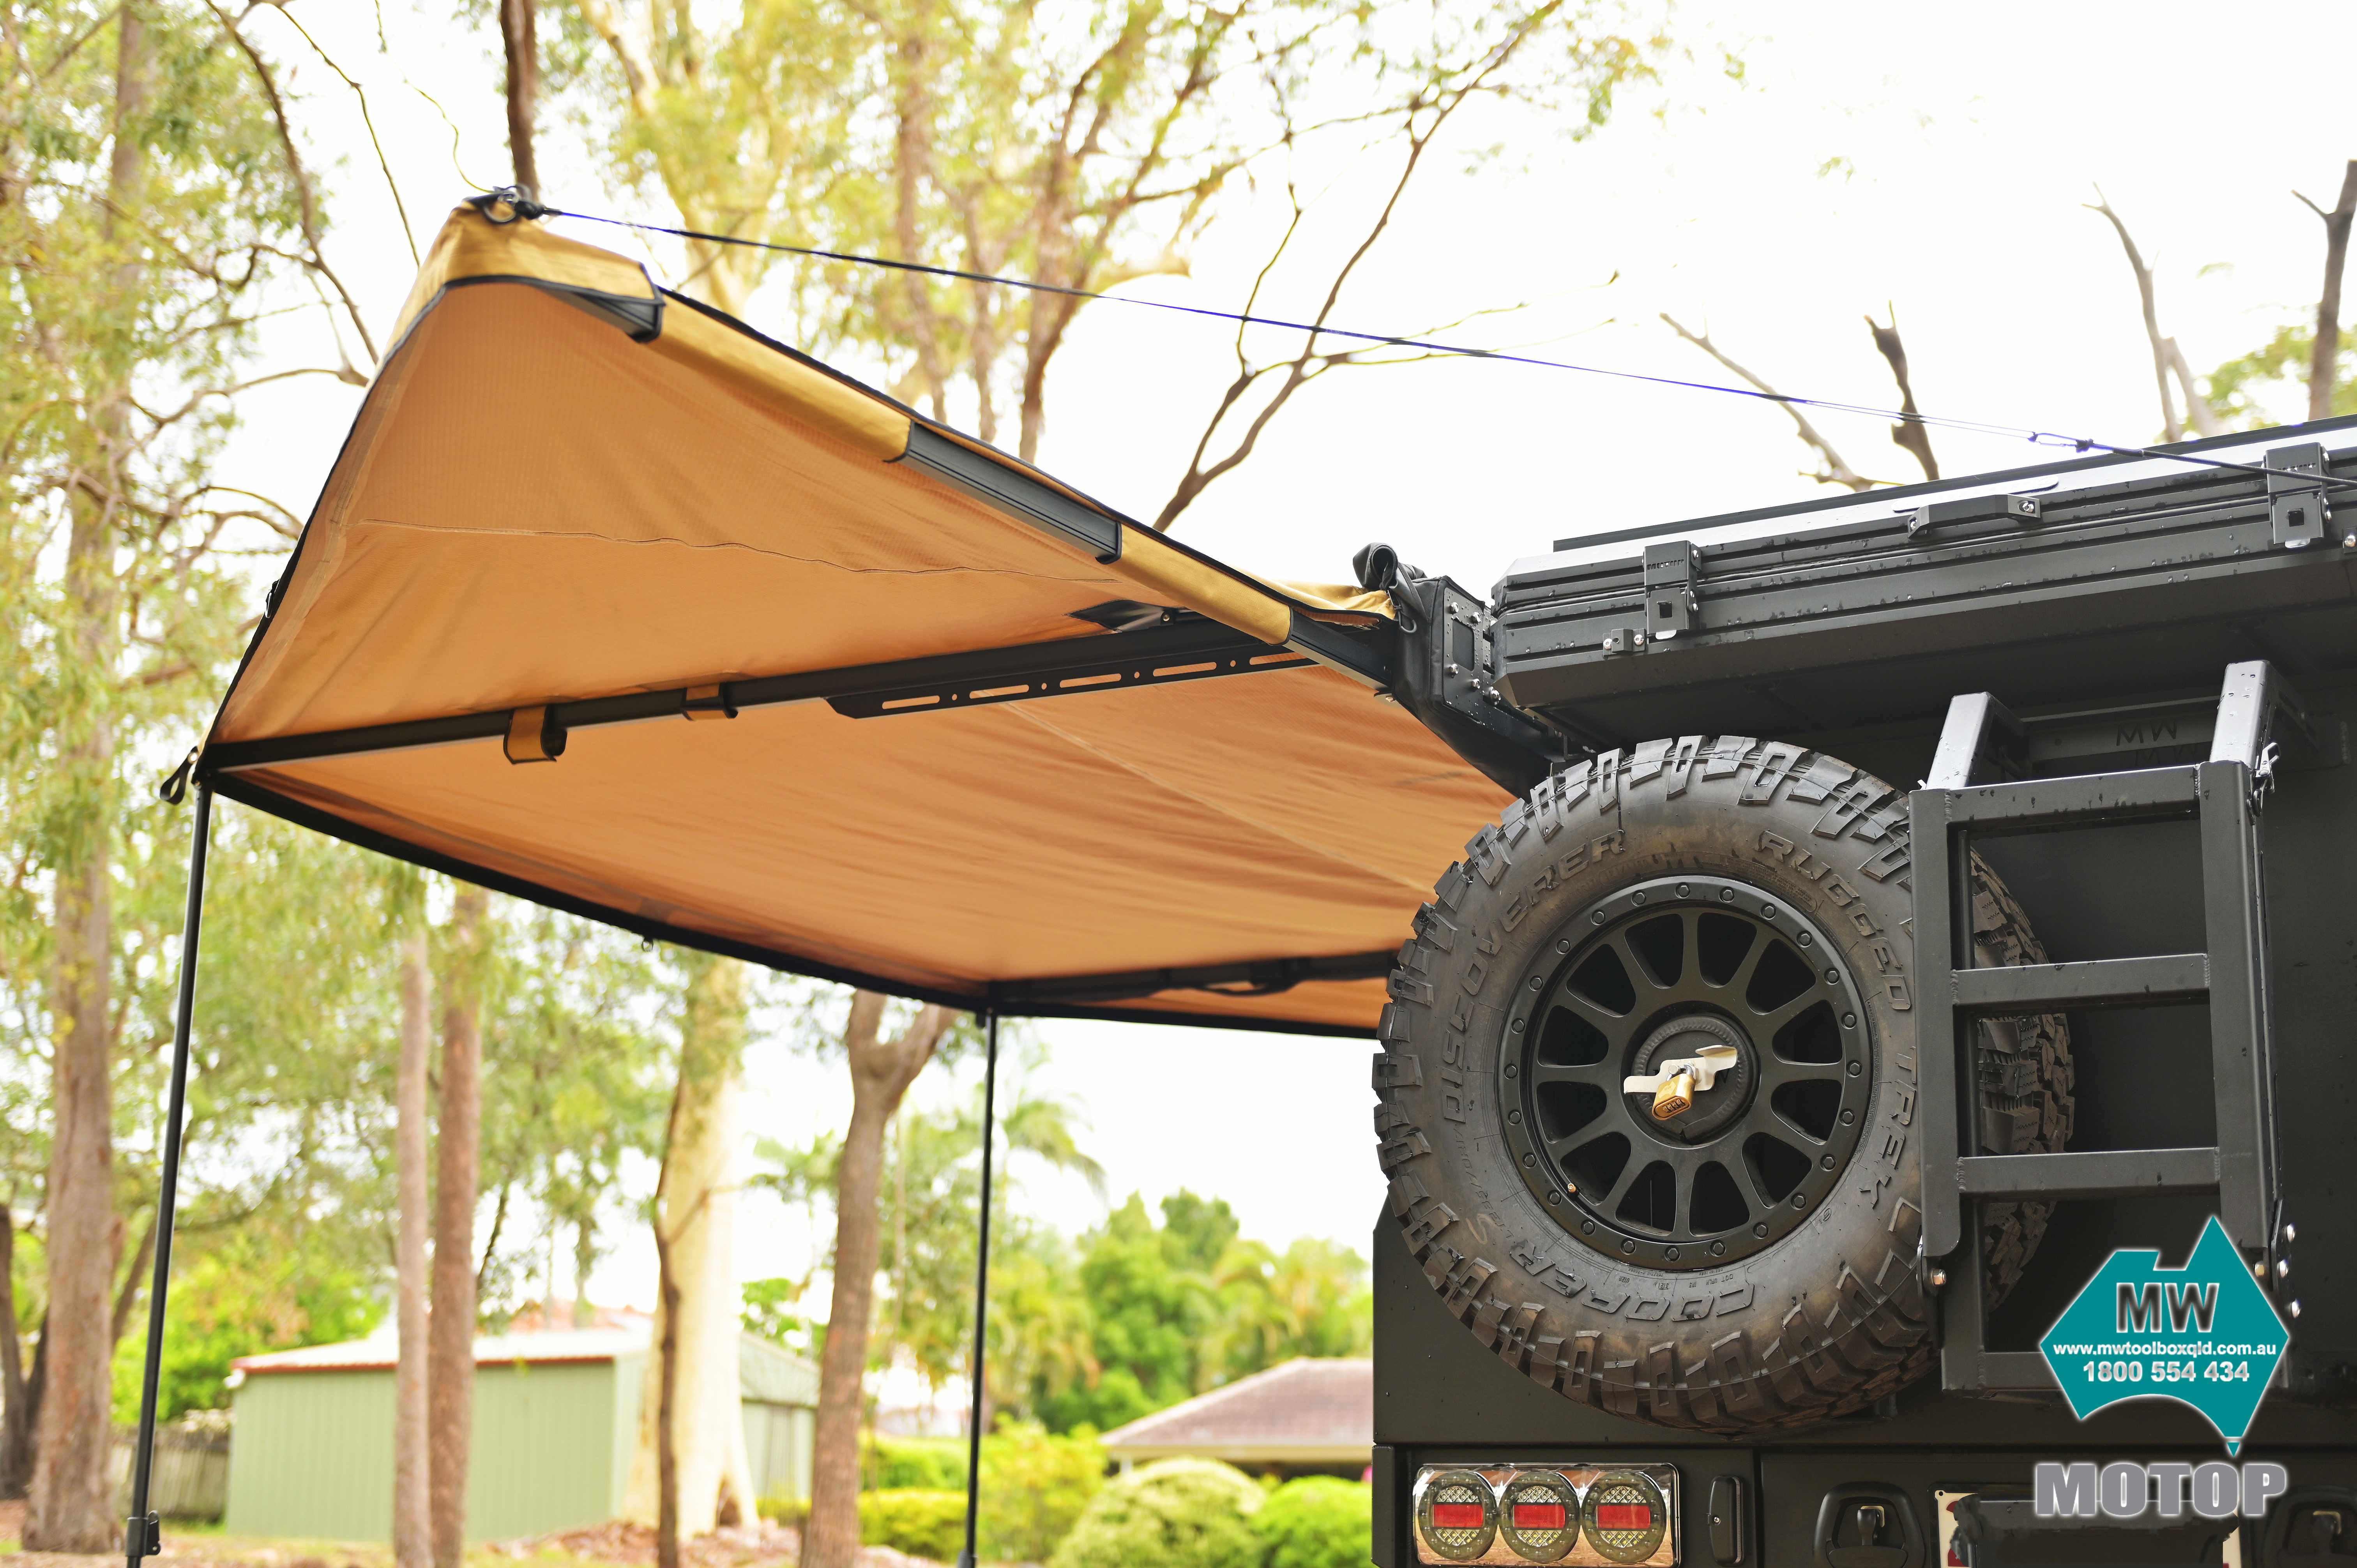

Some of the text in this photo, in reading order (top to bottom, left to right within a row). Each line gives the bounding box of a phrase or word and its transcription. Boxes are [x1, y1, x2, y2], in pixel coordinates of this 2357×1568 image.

[2116, 720, 2177, 746] MW
[1441, 829, 1625, 1123] DISCOVERER
[1754, 830, 1911, 1010] RUGGED
[1858, 1046, 1917, 1209] TREK
[1509, 1240, 1754, 1321] COOPER
